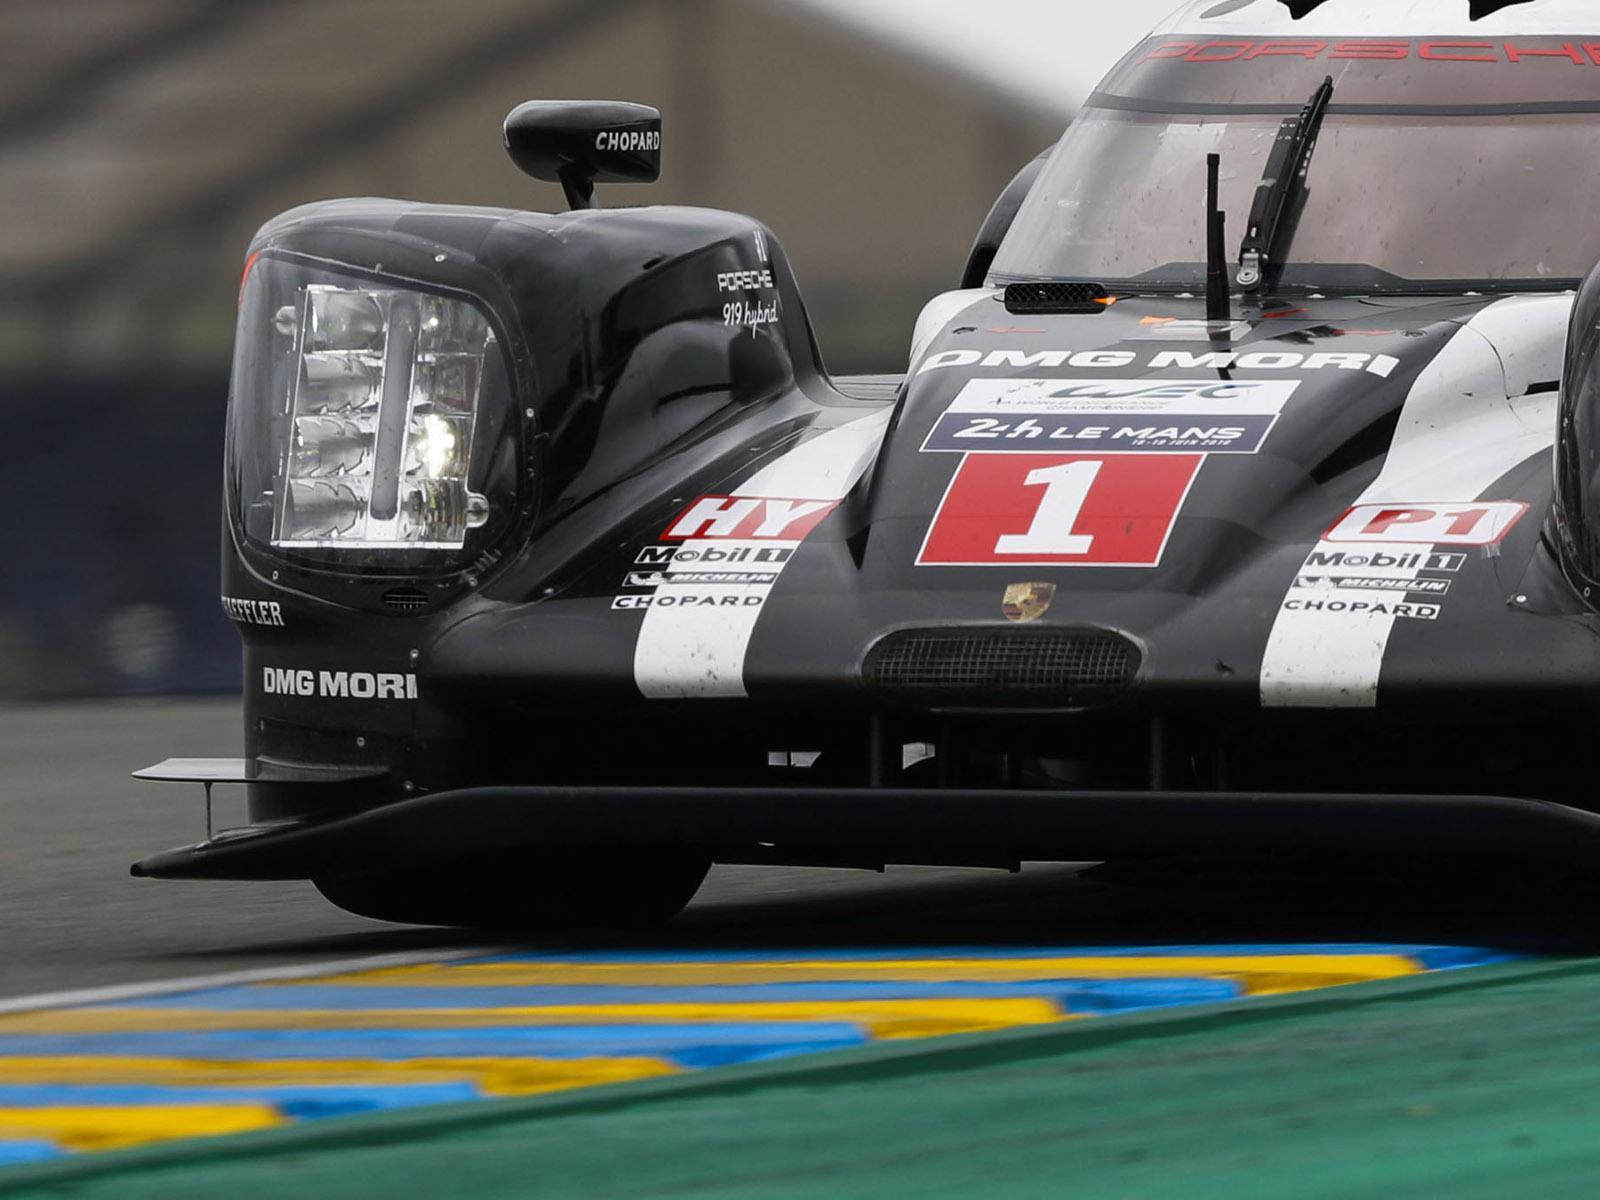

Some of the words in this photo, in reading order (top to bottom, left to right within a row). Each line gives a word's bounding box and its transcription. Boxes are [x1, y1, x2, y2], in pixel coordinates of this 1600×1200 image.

[595, 131, 660, 151] CHOPARD
[717, 269, 773, 292] PORSCHE
[723, 301, 743, 326] 919
[744, 300, 779, 340] hybrid
[916, 350, 1137, 375] DMG
[1147, 351, 1400, 378] MORI
[1049, 426, 1110, 439] LE
[1111, 426, 1246, 440] MANS
[668, 498, 835, 537] HY
[993, 460, 1103, 555] 1
[1360, 509, 1490, 535] P1
[637, 547, 751, 564] Mobil
[1305, 552, 1421, 569] Mobil
[670, 573, 776, 582] MICHELIN
[1339, 579, 1446, 591] MICHELIN
[614, 595, 763, 608] CHOPARD
[1284, 600, 1438, 618] CHOPARD
[263, 667, 315, 696] DMG
[319, 671, 418, 699] MORI
